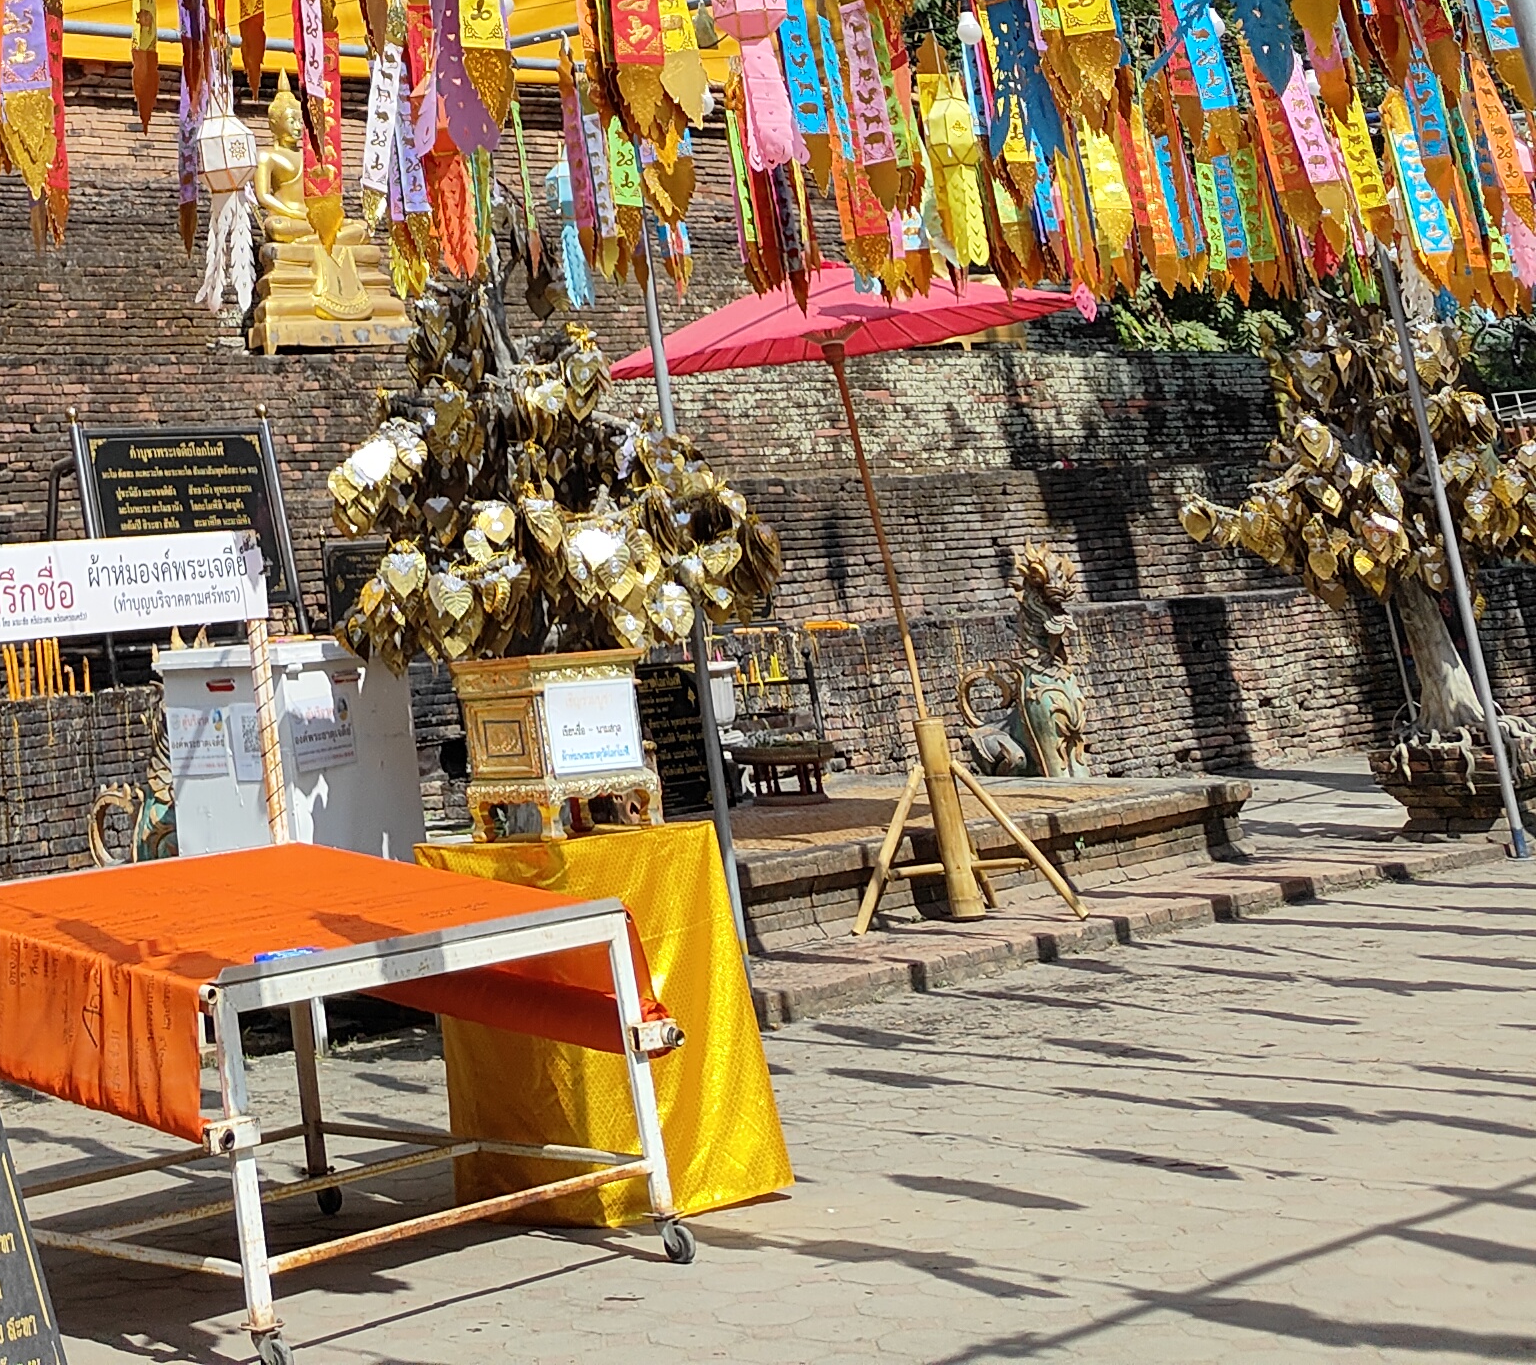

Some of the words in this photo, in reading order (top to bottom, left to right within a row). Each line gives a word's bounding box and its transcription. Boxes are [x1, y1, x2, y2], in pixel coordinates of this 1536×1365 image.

[87, 545, 248, 588] ผ้าห่มองค์พระเจดีย์
[113, 585, 241, 617] (ทำบุญบริจาคตามศรัทธา)
